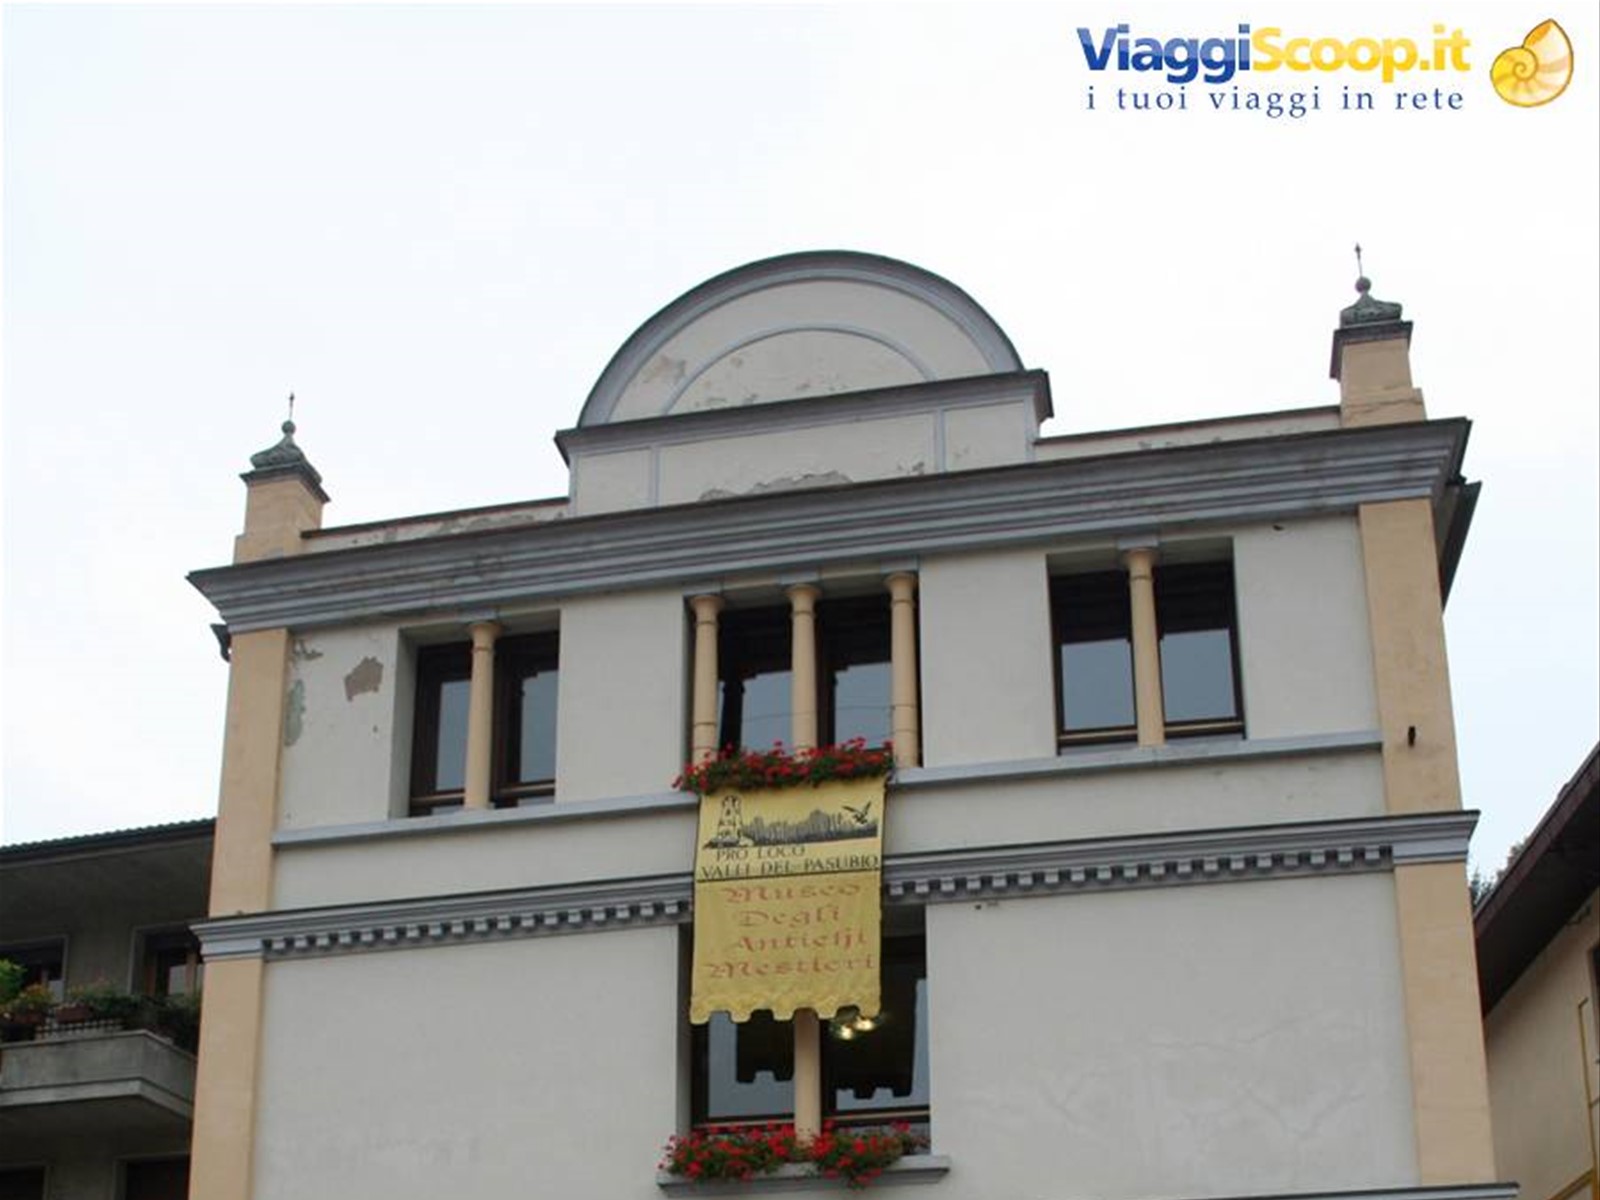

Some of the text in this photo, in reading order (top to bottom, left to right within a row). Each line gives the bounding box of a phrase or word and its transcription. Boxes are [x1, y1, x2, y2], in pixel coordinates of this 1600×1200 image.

[716, 846, 806, 862] PRO LOCO
[701, 855, 879, 879] VALLI DEL PASUBIO
